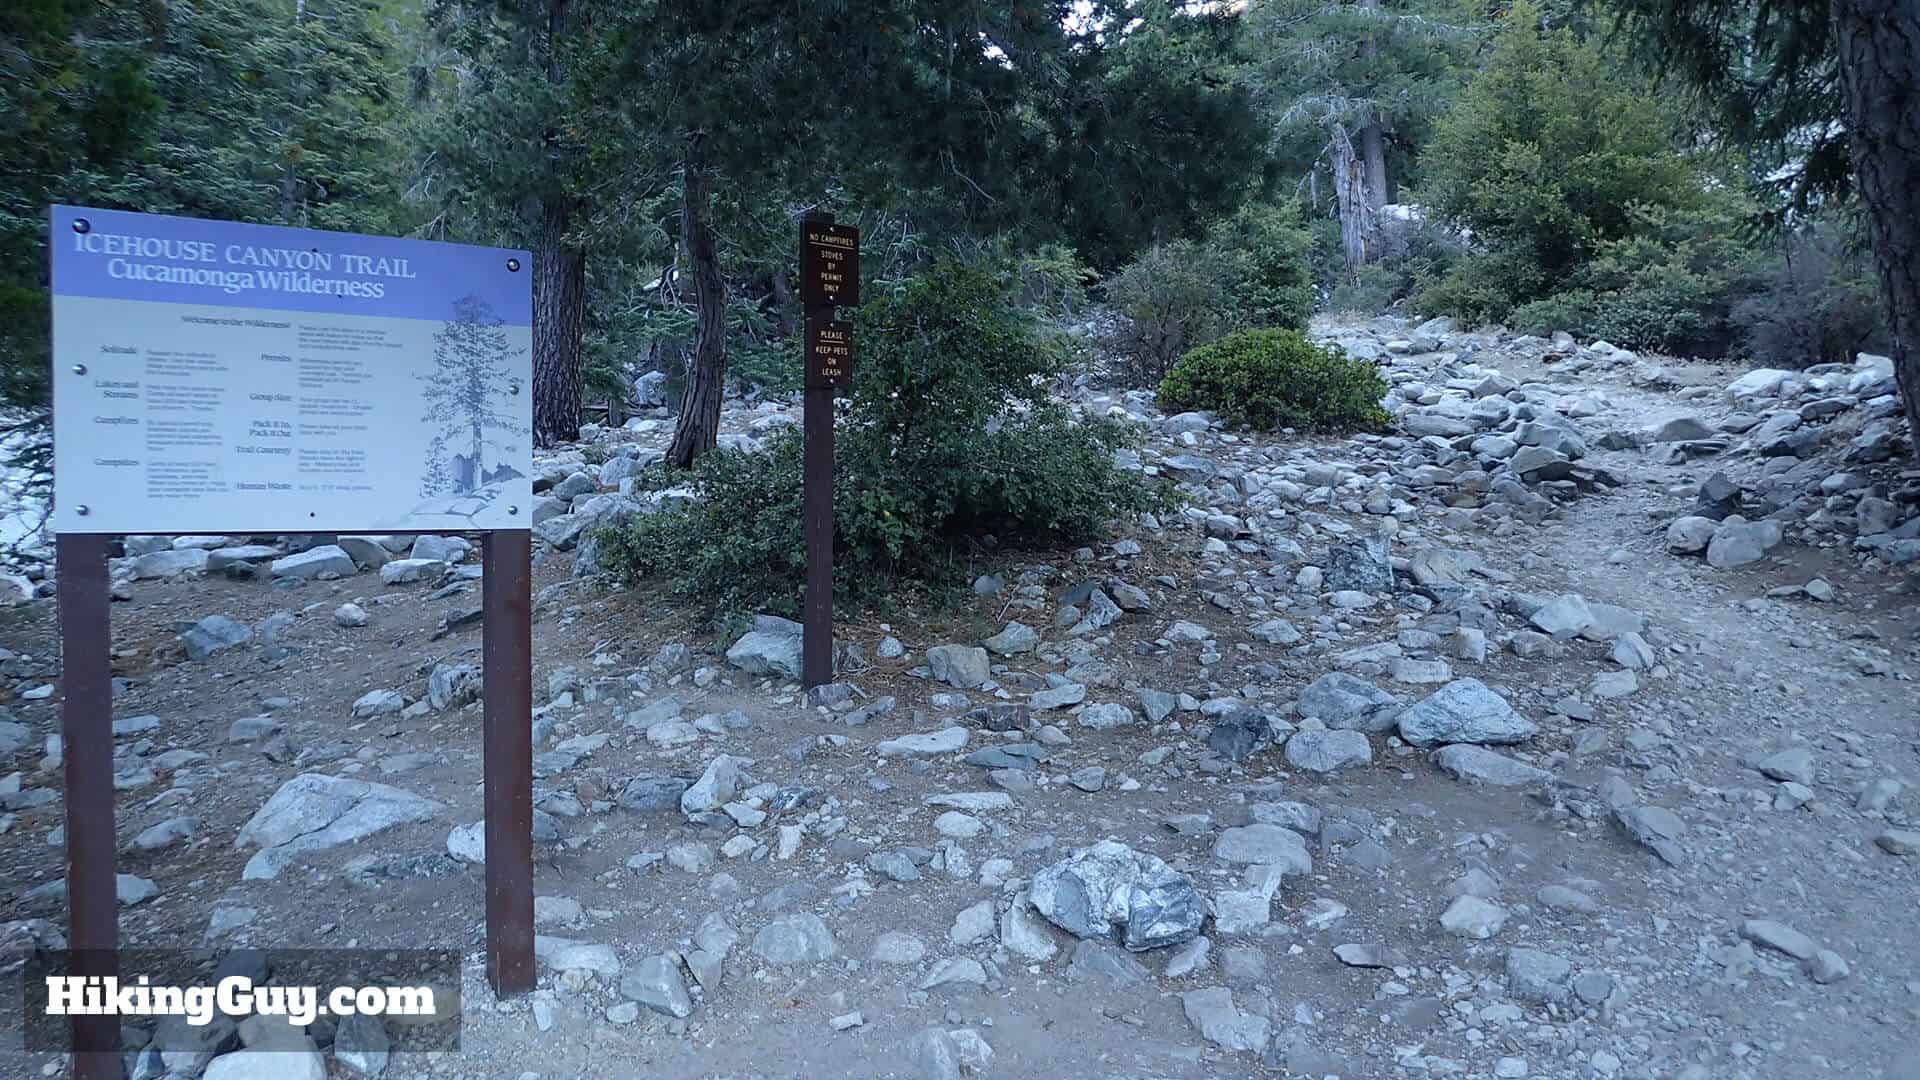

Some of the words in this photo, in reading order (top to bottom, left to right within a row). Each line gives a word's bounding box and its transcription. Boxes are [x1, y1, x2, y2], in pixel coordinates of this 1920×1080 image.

[809, 233, 819, 242] NO
[820, 234, 854, 247] CAMPFIRES
[75, 233, 217, 262] ICEHOUSE
[225, 245, 332, 272] CANYON
[339, 254, 416, 278] TRAIL
[820, 250, 844, 261] STOVES
[827, 262, 836, 270] BY
[107, 258, 256, 293] Cucamonga
[256, 270, 385, 299] Wilderness
[820, 272, 843, 281] PERMIT
[823, 283, 839, 292] ONLY
[820, 330, 843, 340] PLEASE
[815, 346, 831, 354] KEEP
[833, 346, 848, 356] PETS
[827, 357, 837, 366] ON
[822, 368, 842, 377] LEASH
